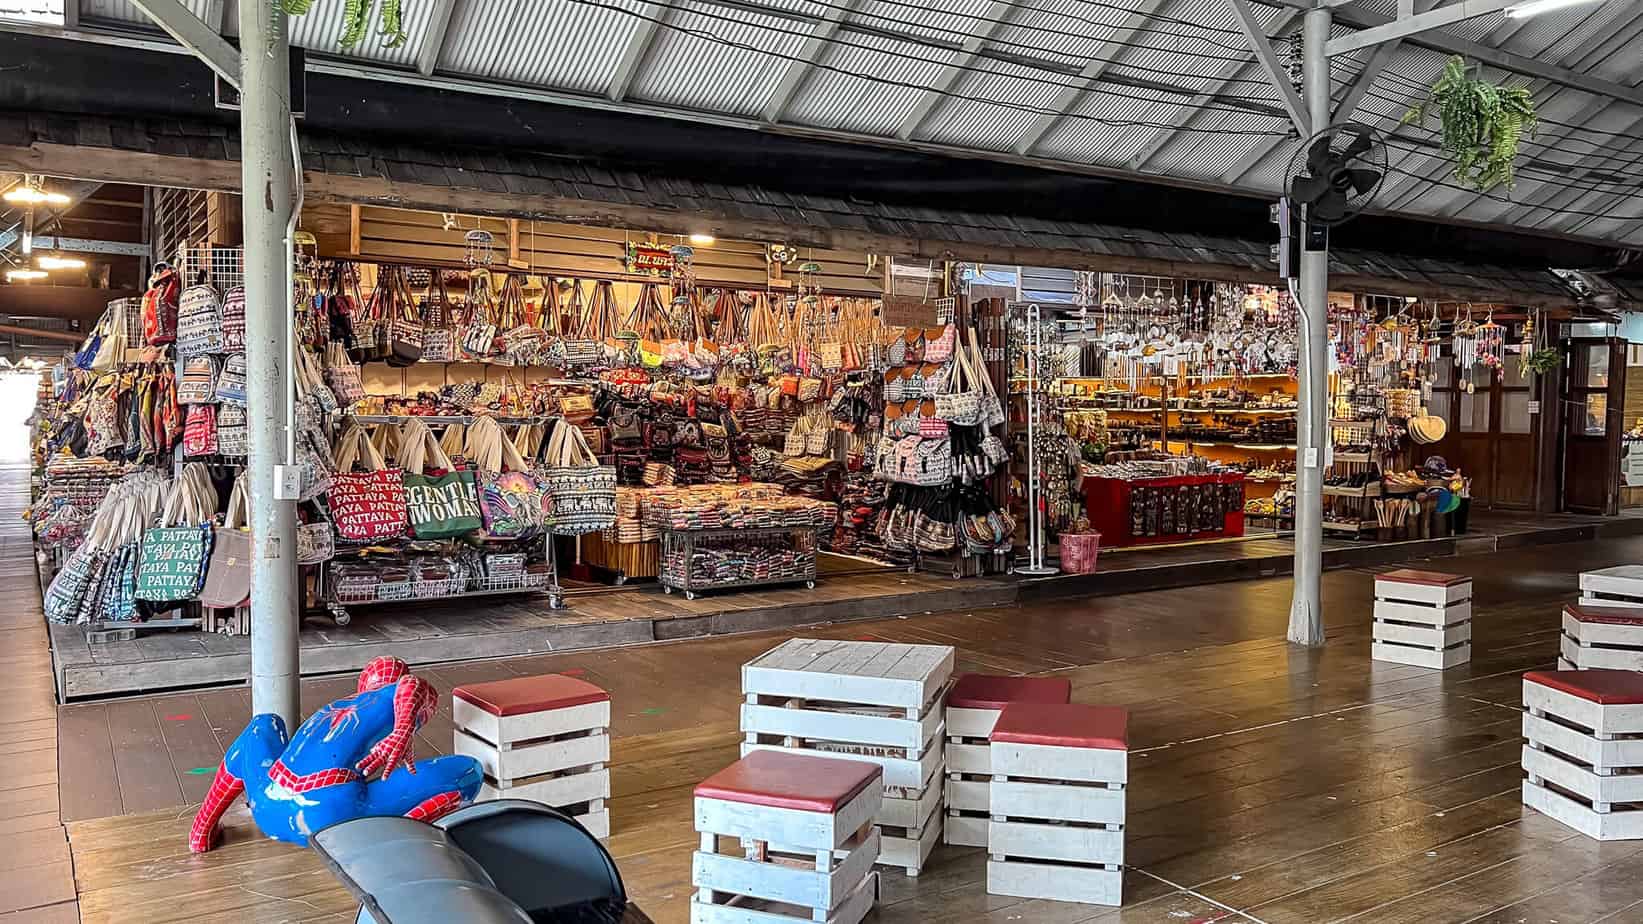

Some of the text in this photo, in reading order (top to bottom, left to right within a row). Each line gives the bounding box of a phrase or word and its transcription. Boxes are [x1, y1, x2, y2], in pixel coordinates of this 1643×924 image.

[329, 474, 380, 485] PATTAYA
[327, 484, 358, 497] TAYA
[335, 492, 387, 505] PATTAYA
[332, 502, 363, 518] TAYA
[342, 511, 394, 524] PATTAYA
[147, 576, 198, 588] PATTAYA
